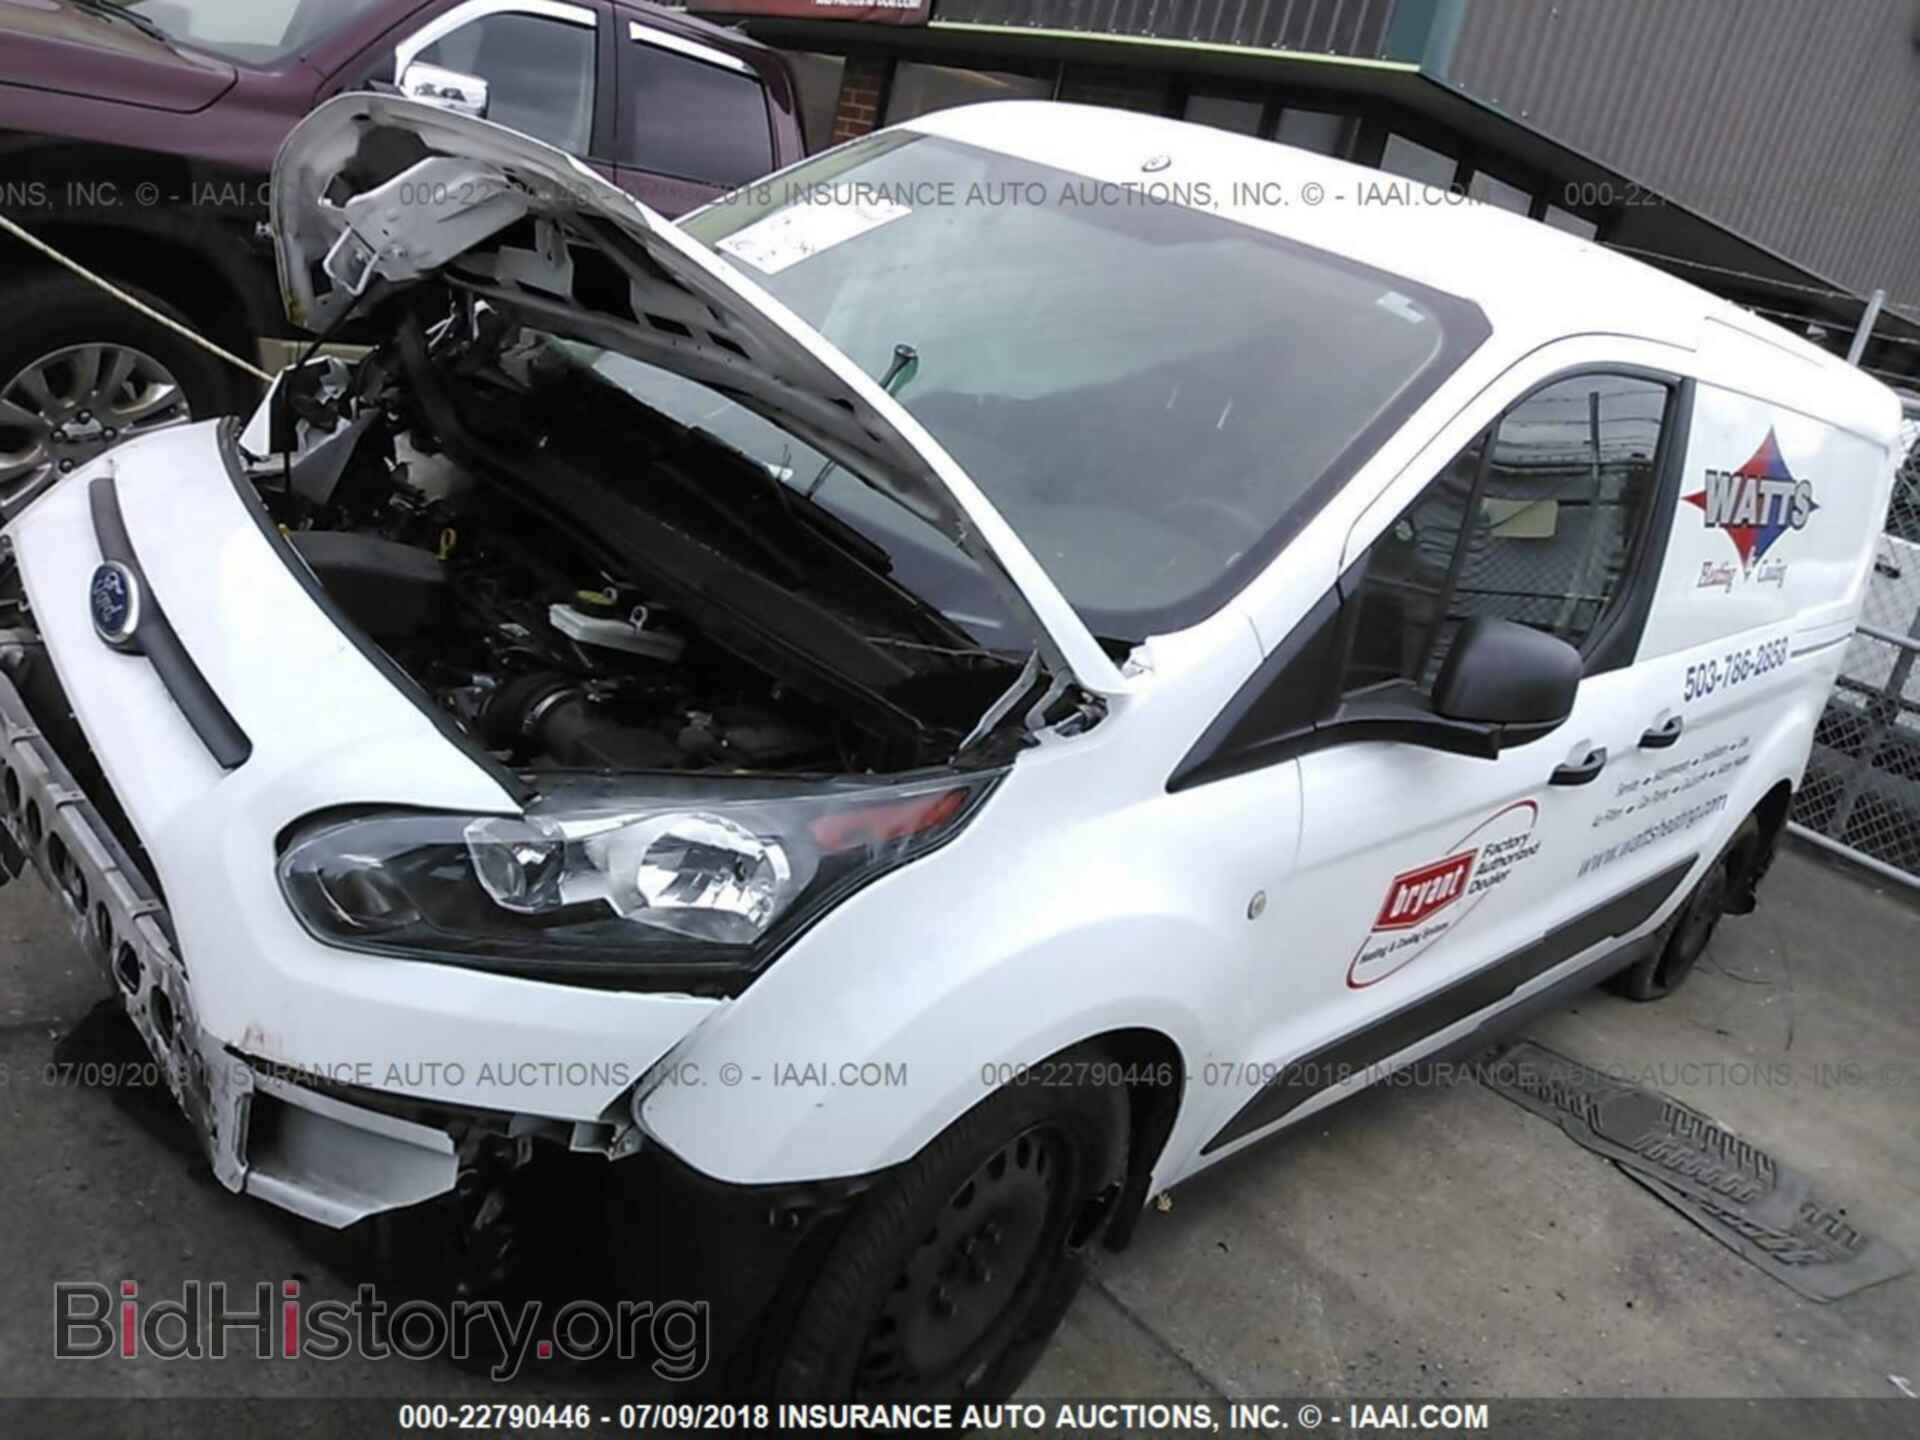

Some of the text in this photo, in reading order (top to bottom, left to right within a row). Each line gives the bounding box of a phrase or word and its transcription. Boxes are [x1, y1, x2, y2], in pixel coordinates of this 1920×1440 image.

[1704, 469, 1813, 531] WATTS
[1474, 840, 1541, 877] Authorized
[1482, 832, 1531, 859] Factory
[1390, 864, 1465, 918] bryant
[1468, 869, 1511, 895] Dealer
